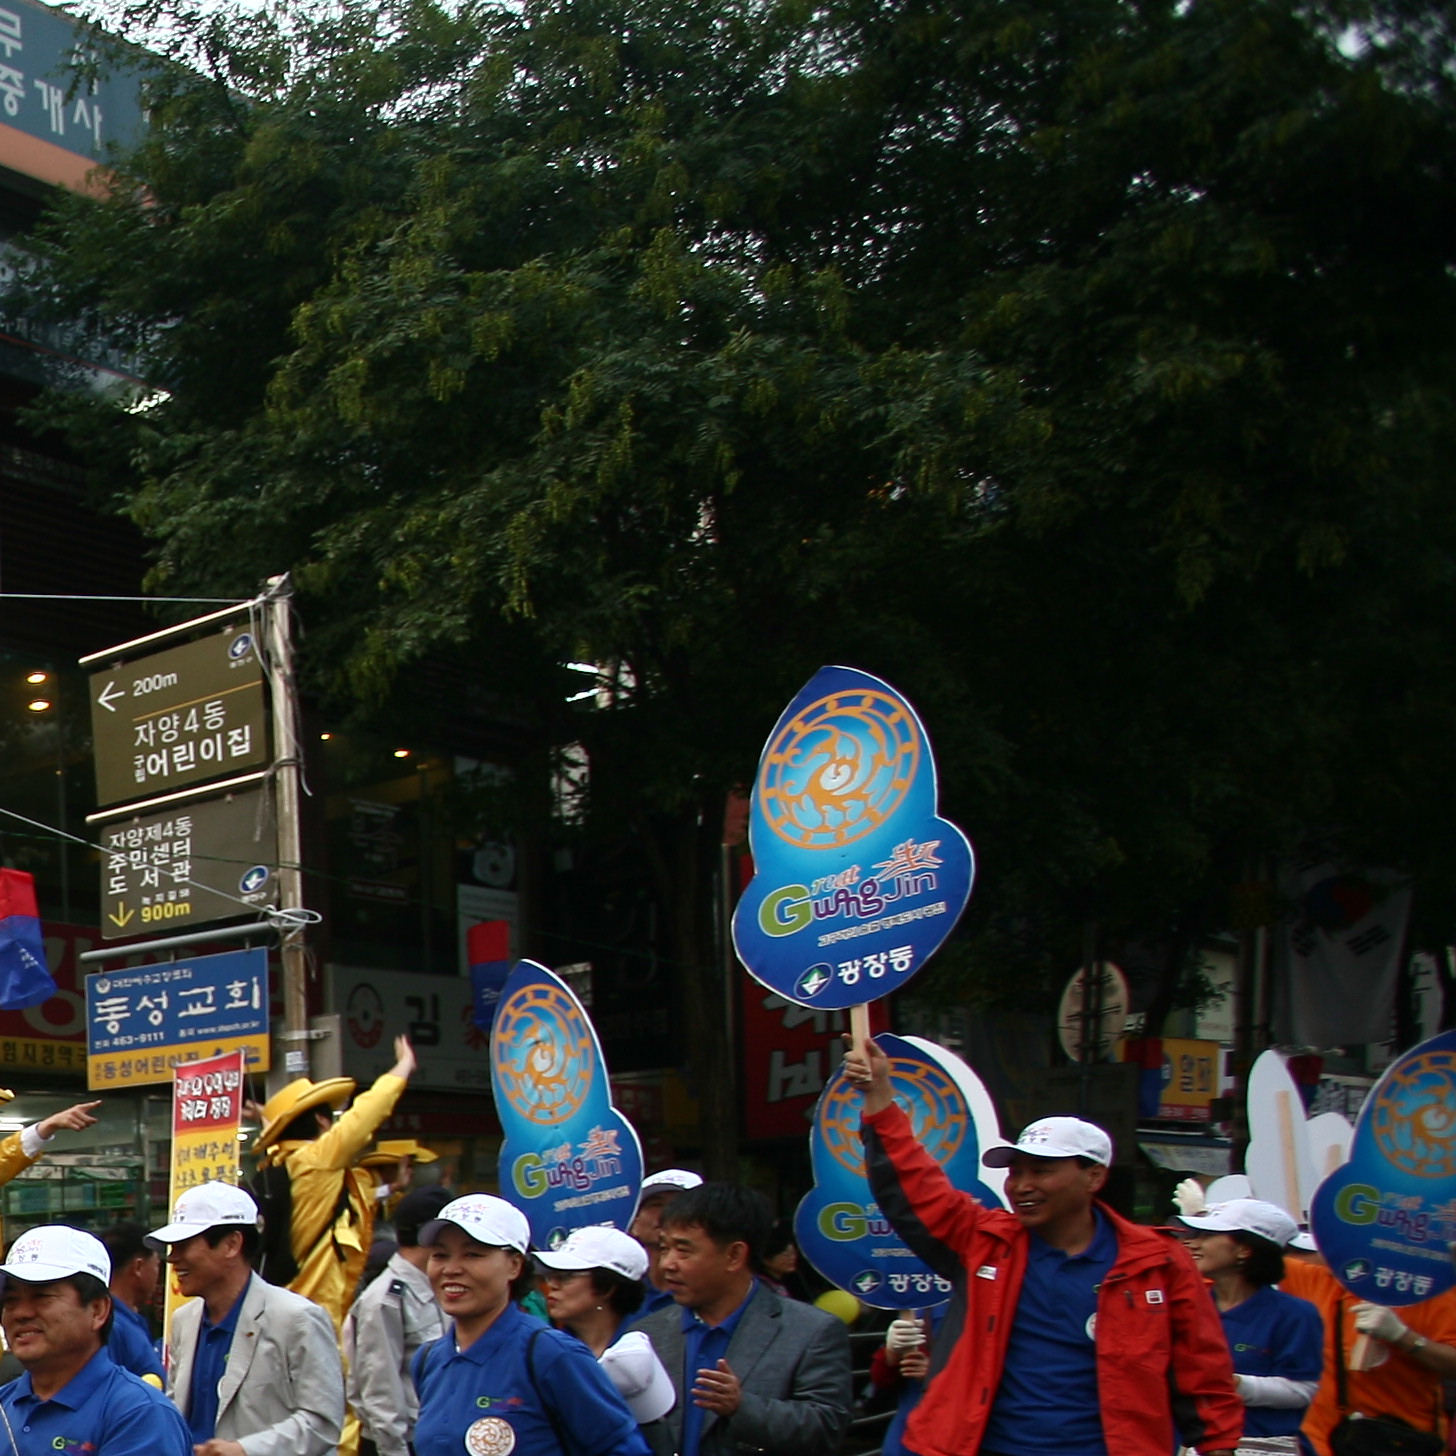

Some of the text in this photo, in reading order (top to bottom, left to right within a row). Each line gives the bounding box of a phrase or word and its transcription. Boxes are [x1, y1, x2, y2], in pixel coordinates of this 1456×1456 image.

[132, 671, 179, 698] 200m
[146, 724, 251, 778] 어린이집
[107, 837, 192, 874] 주민센터
[140, 901, 192, 924] 900m
[836, 944, 915, 986] 광장동
